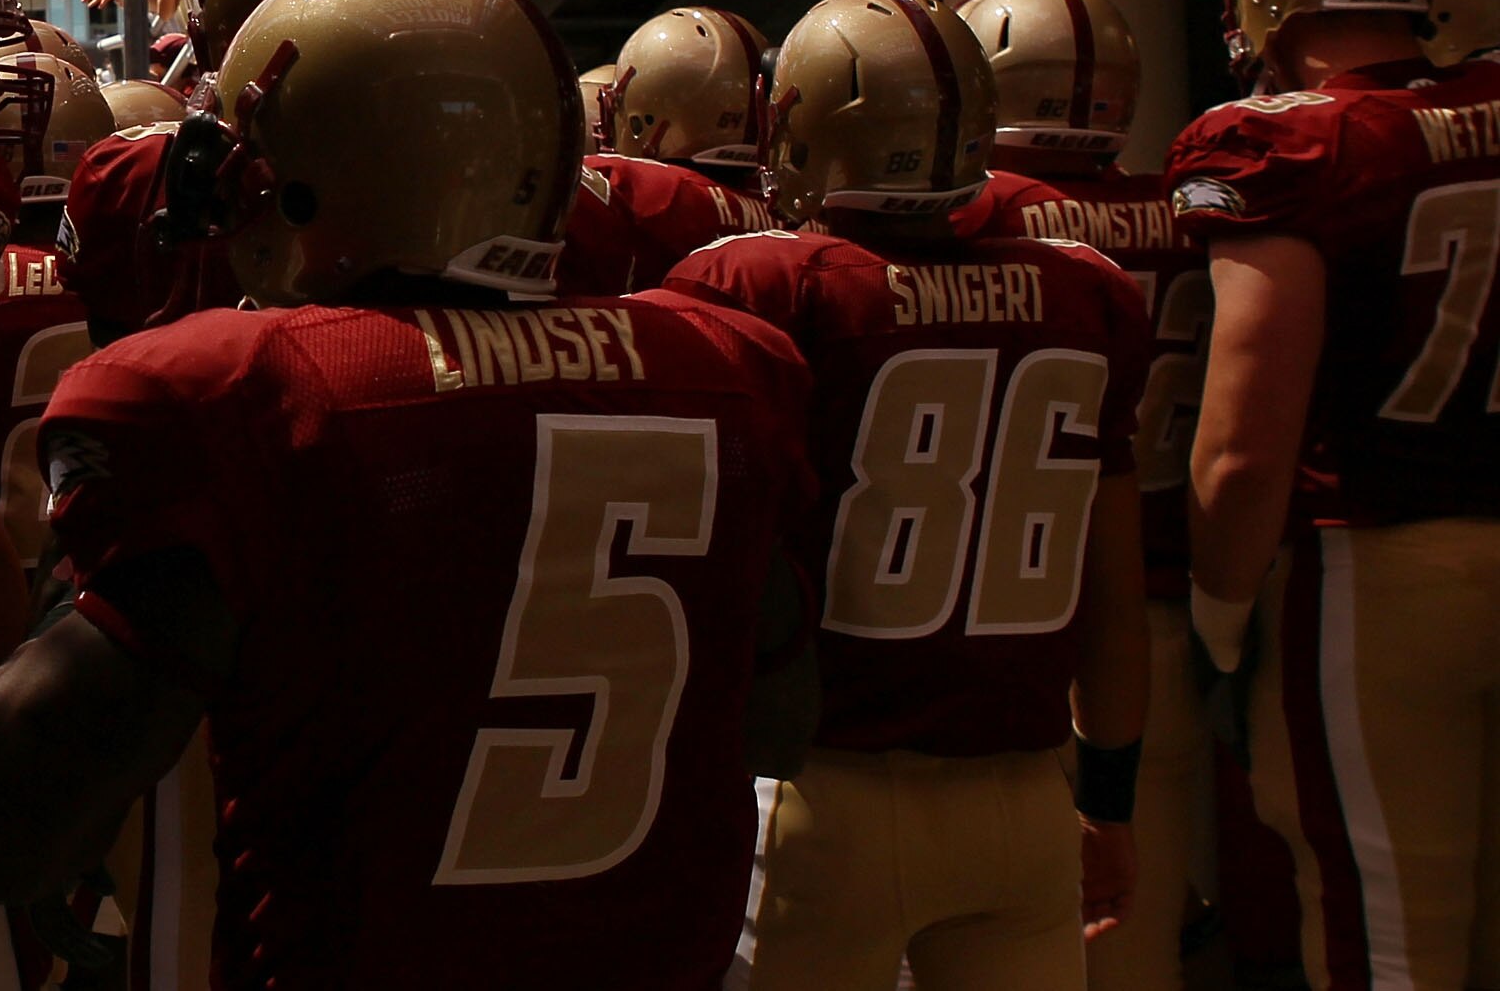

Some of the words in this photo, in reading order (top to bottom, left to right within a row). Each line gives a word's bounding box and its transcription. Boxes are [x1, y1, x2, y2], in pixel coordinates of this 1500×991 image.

[513, 167, 541, 206] 5
[887, 264, 1043, 326] SWIGERT
[414, 308, 647, 393] LINDSEY
[820, 348, 1109, 640] 86
[431, 414, 718, 887] 5
